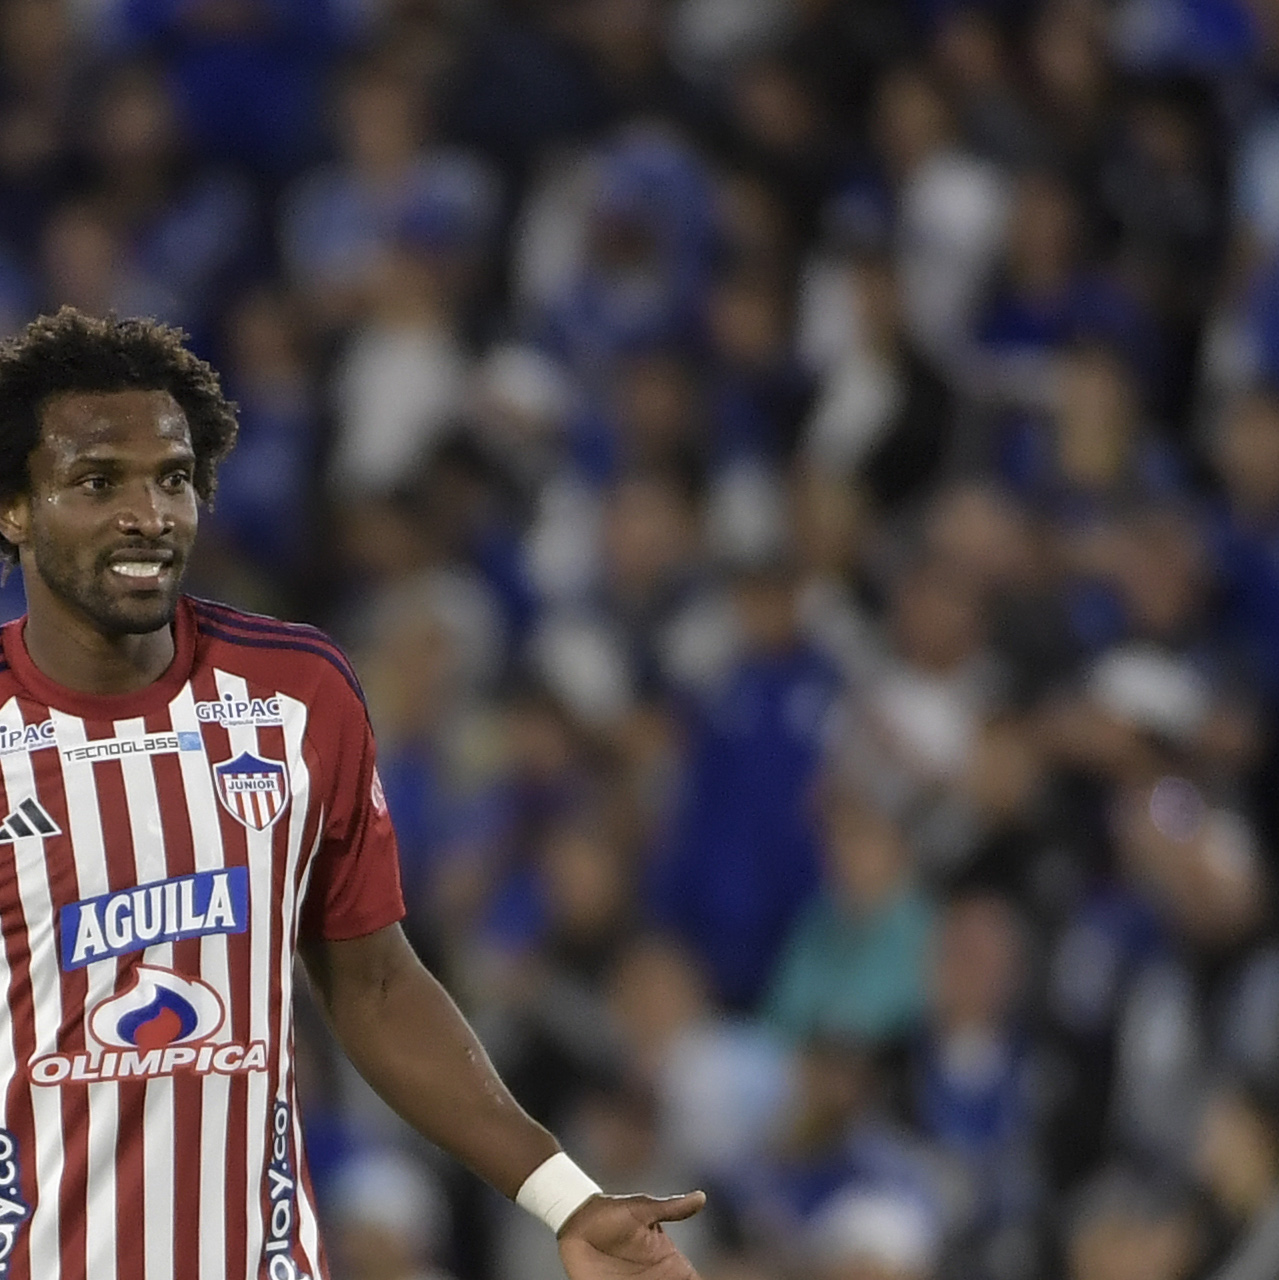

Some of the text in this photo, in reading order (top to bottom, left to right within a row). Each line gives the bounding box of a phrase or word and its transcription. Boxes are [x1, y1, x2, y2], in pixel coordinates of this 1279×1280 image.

[228, 780, 275, 790] JUNIOR
[70, 873, 237, 964] AGUILA
[31, 1044, 267, 1083] OLIMPICA
